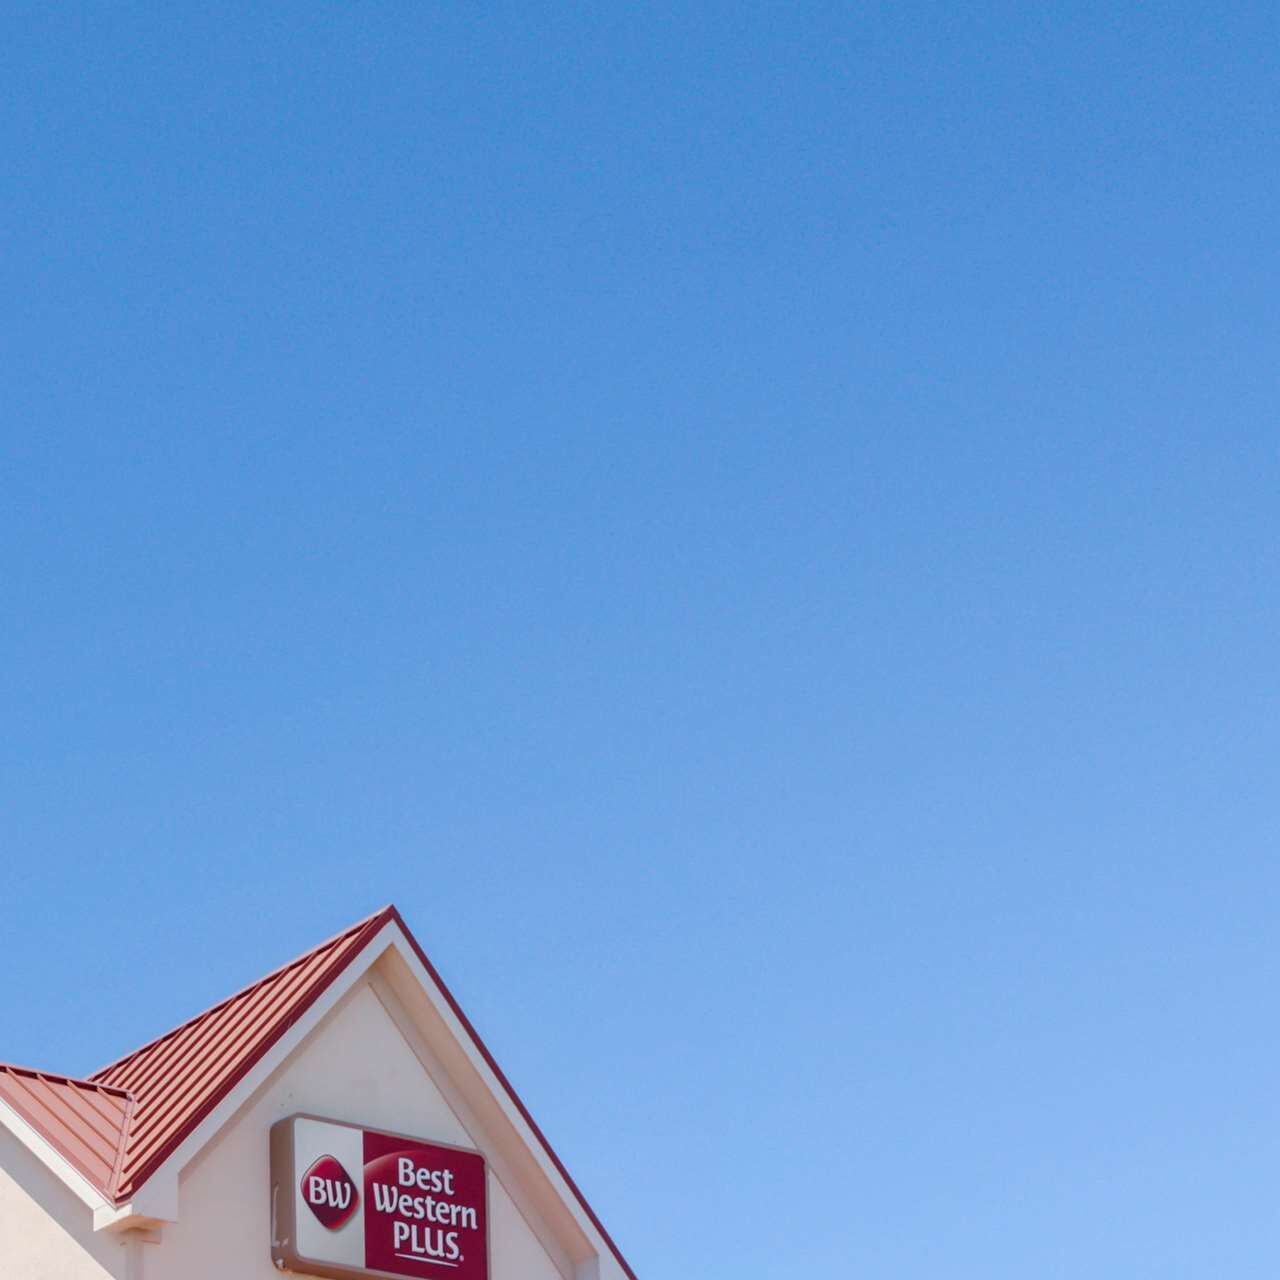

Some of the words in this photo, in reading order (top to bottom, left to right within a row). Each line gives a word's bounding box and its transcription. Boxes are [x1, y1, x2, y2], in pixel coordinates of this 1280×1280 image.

[309, 1176, 351, 1209] BW
[397, 1157, 455, 1195] Best
[372, 1182, 478, 1230] Western
